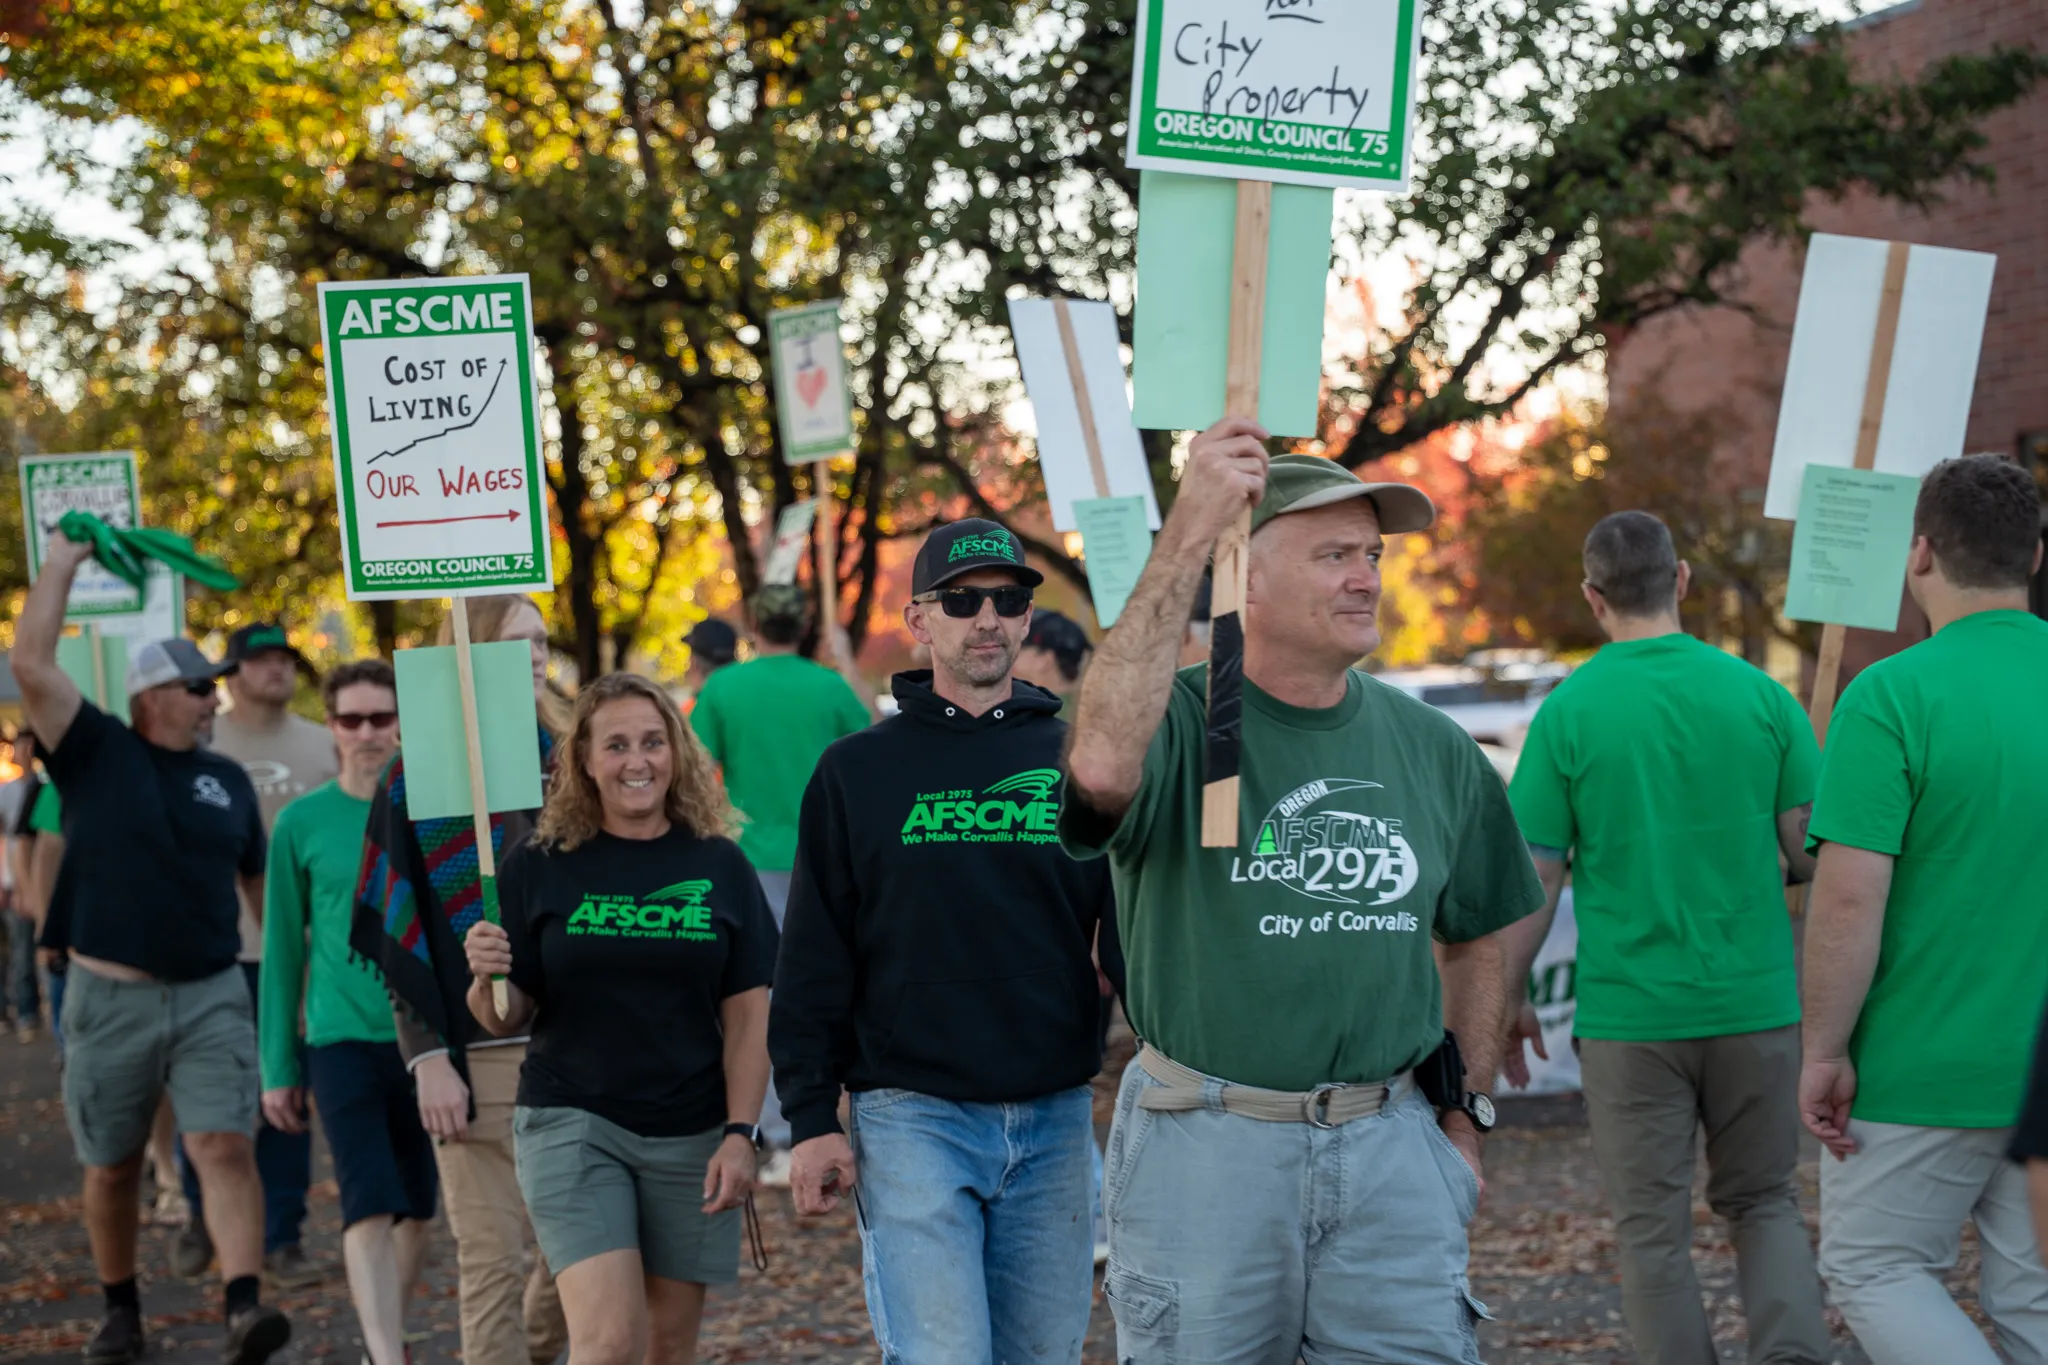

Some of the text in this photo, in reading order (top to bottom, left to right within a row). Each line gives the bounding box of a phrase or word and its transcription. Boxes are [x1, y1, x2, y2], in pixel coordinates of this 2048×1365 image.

[1174, 20, 1262, 77] City
[1202, 65, 1369, 139] Property
[1154, 111, 1389, 156] OREGON COUNCIL 75
[338, 292, 514, 335] AFSCME
[384, 356, 488, 386] COST OF
[369, 394, 472, 422] LIVING
[367, 465, 523, 499] OUR WAGES
[948, 539, 1015, 559] AFSCME
[361, 554, 534, 577] OREGON COUNCIL 75
[916, 789, 973, 802] Local 2975
[1278, 779, 1329, 818] OREGON
[901, 800, 1059, 833] AFSCME
[901, 834, 923, 845] We
[925, 831, 958, 842] Make
[961, 831, 1014, 842] Corvallis
[1251, 816, 1403, 856] AFSCME
[1230, 847, 1408, 900] Local 2975
[568, 901, 712, 930] AFSCME
[1259, 911, 1419, 938] City of Corvallis
[587, 926, 619, 936] Make
[621, 927, 673, 939] Corvallis
